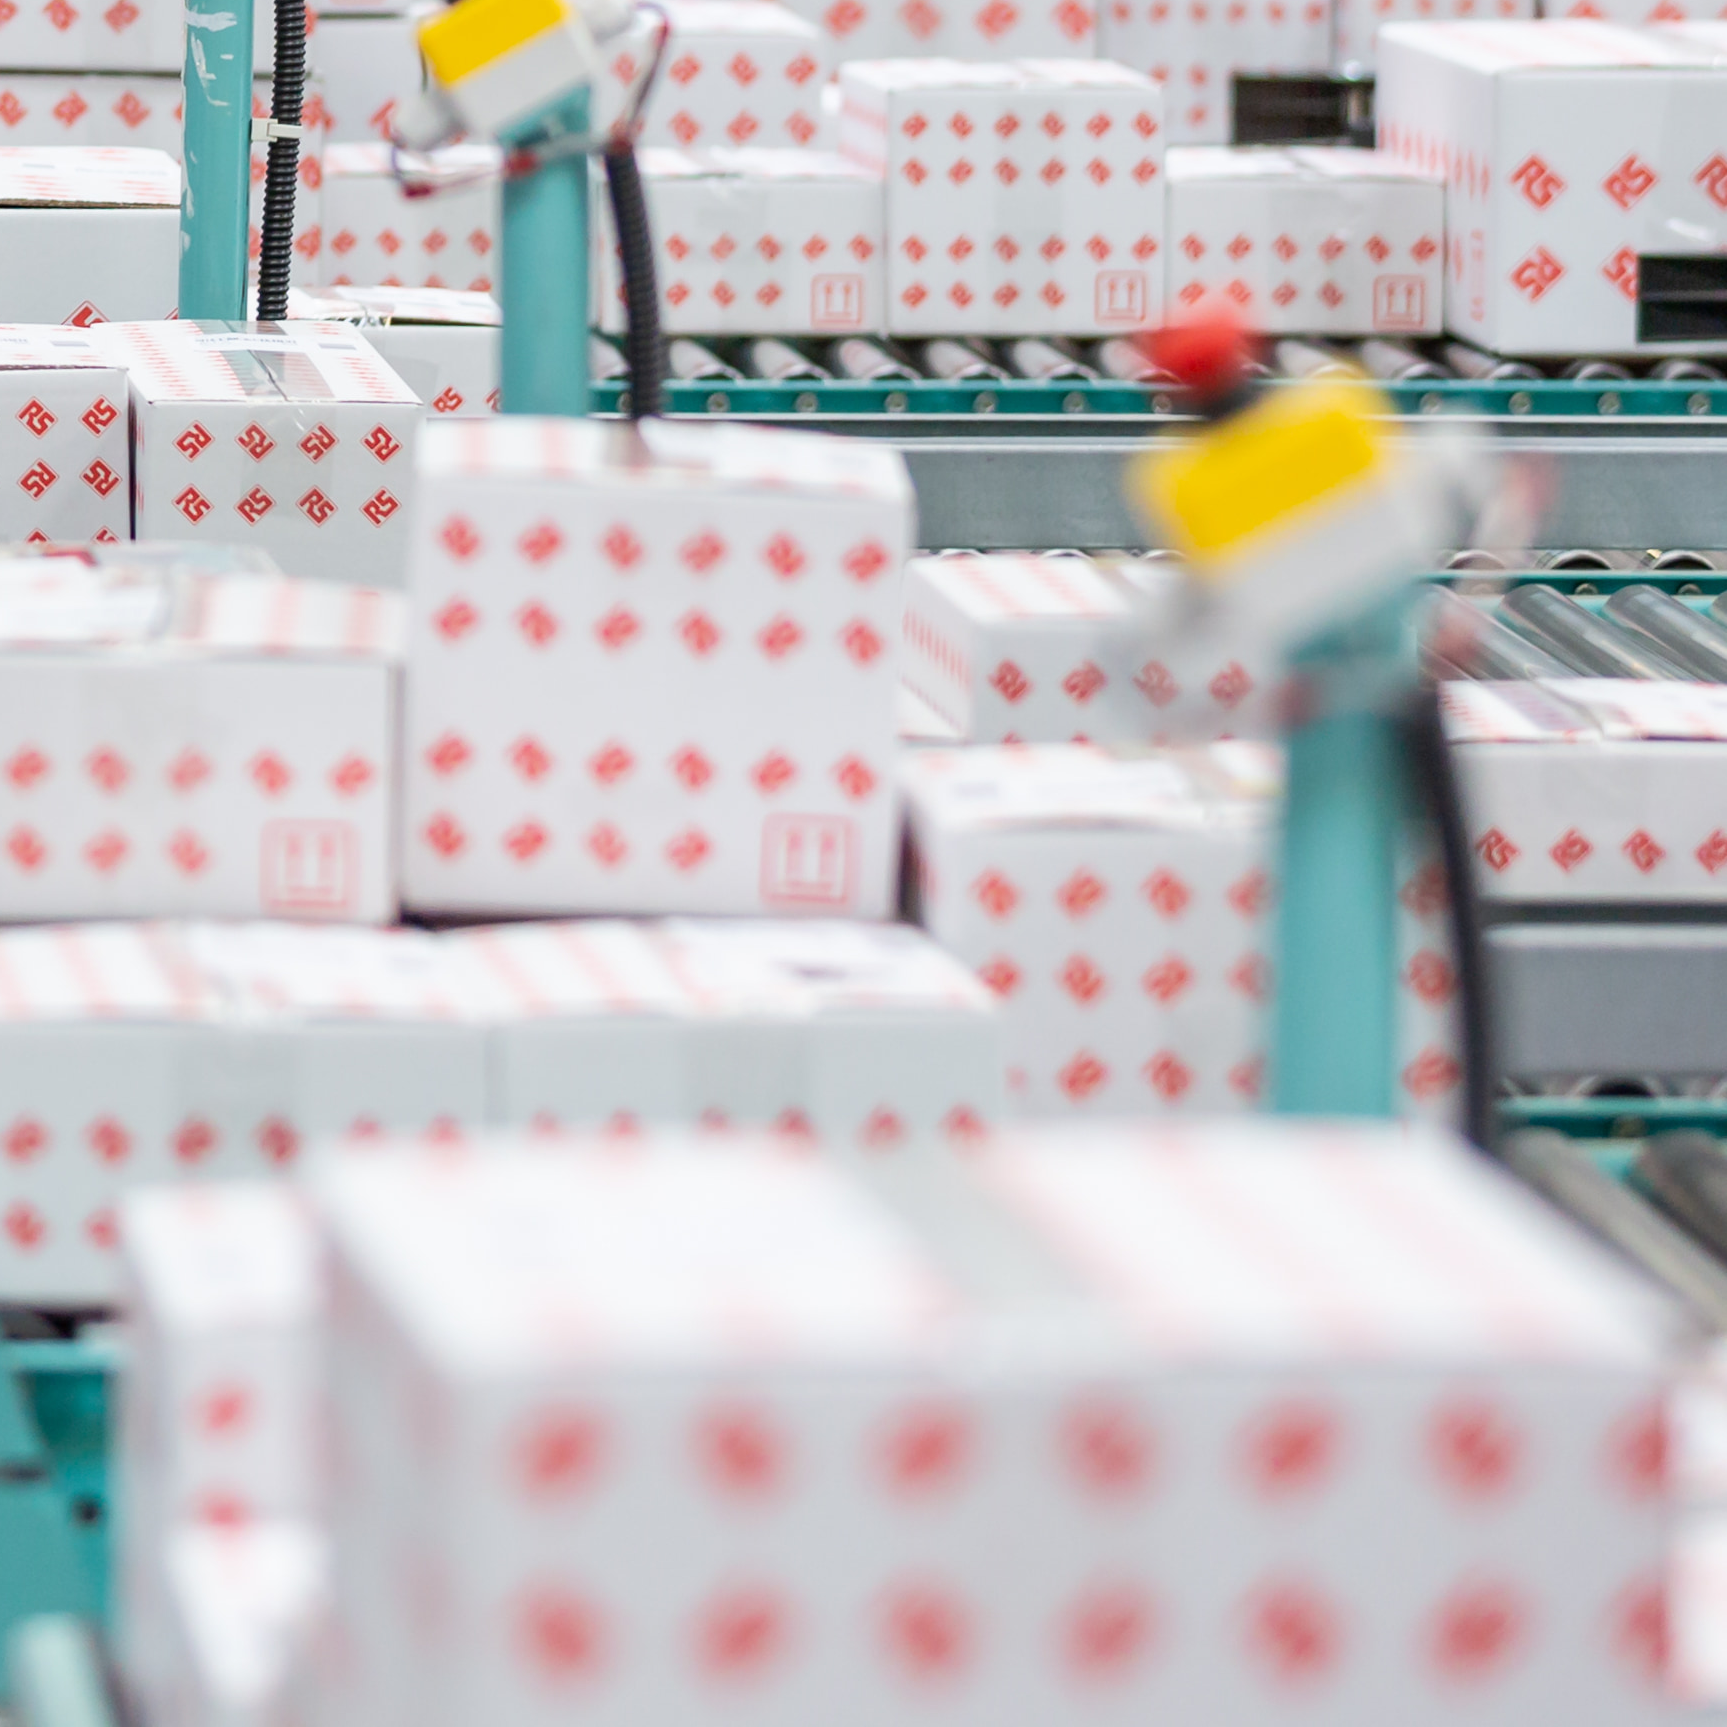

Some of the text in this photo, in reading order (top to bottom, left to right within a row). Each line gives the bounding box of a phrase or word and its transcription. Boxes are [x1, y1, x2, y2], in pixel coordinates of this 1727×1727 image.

[1511, 156, 1656, 209] RS RS
[1511, 249, 1564, 300] RS
[18, 399, 56, 437] RS
[81, 397, 118, 436] RS
[175, 423, 400, 462] RS RS RS RS
[20, 461, 57, 499] RS
[82, 459, 120, 497] RS
[174, 486, 399, 526] RS RS RS RS
